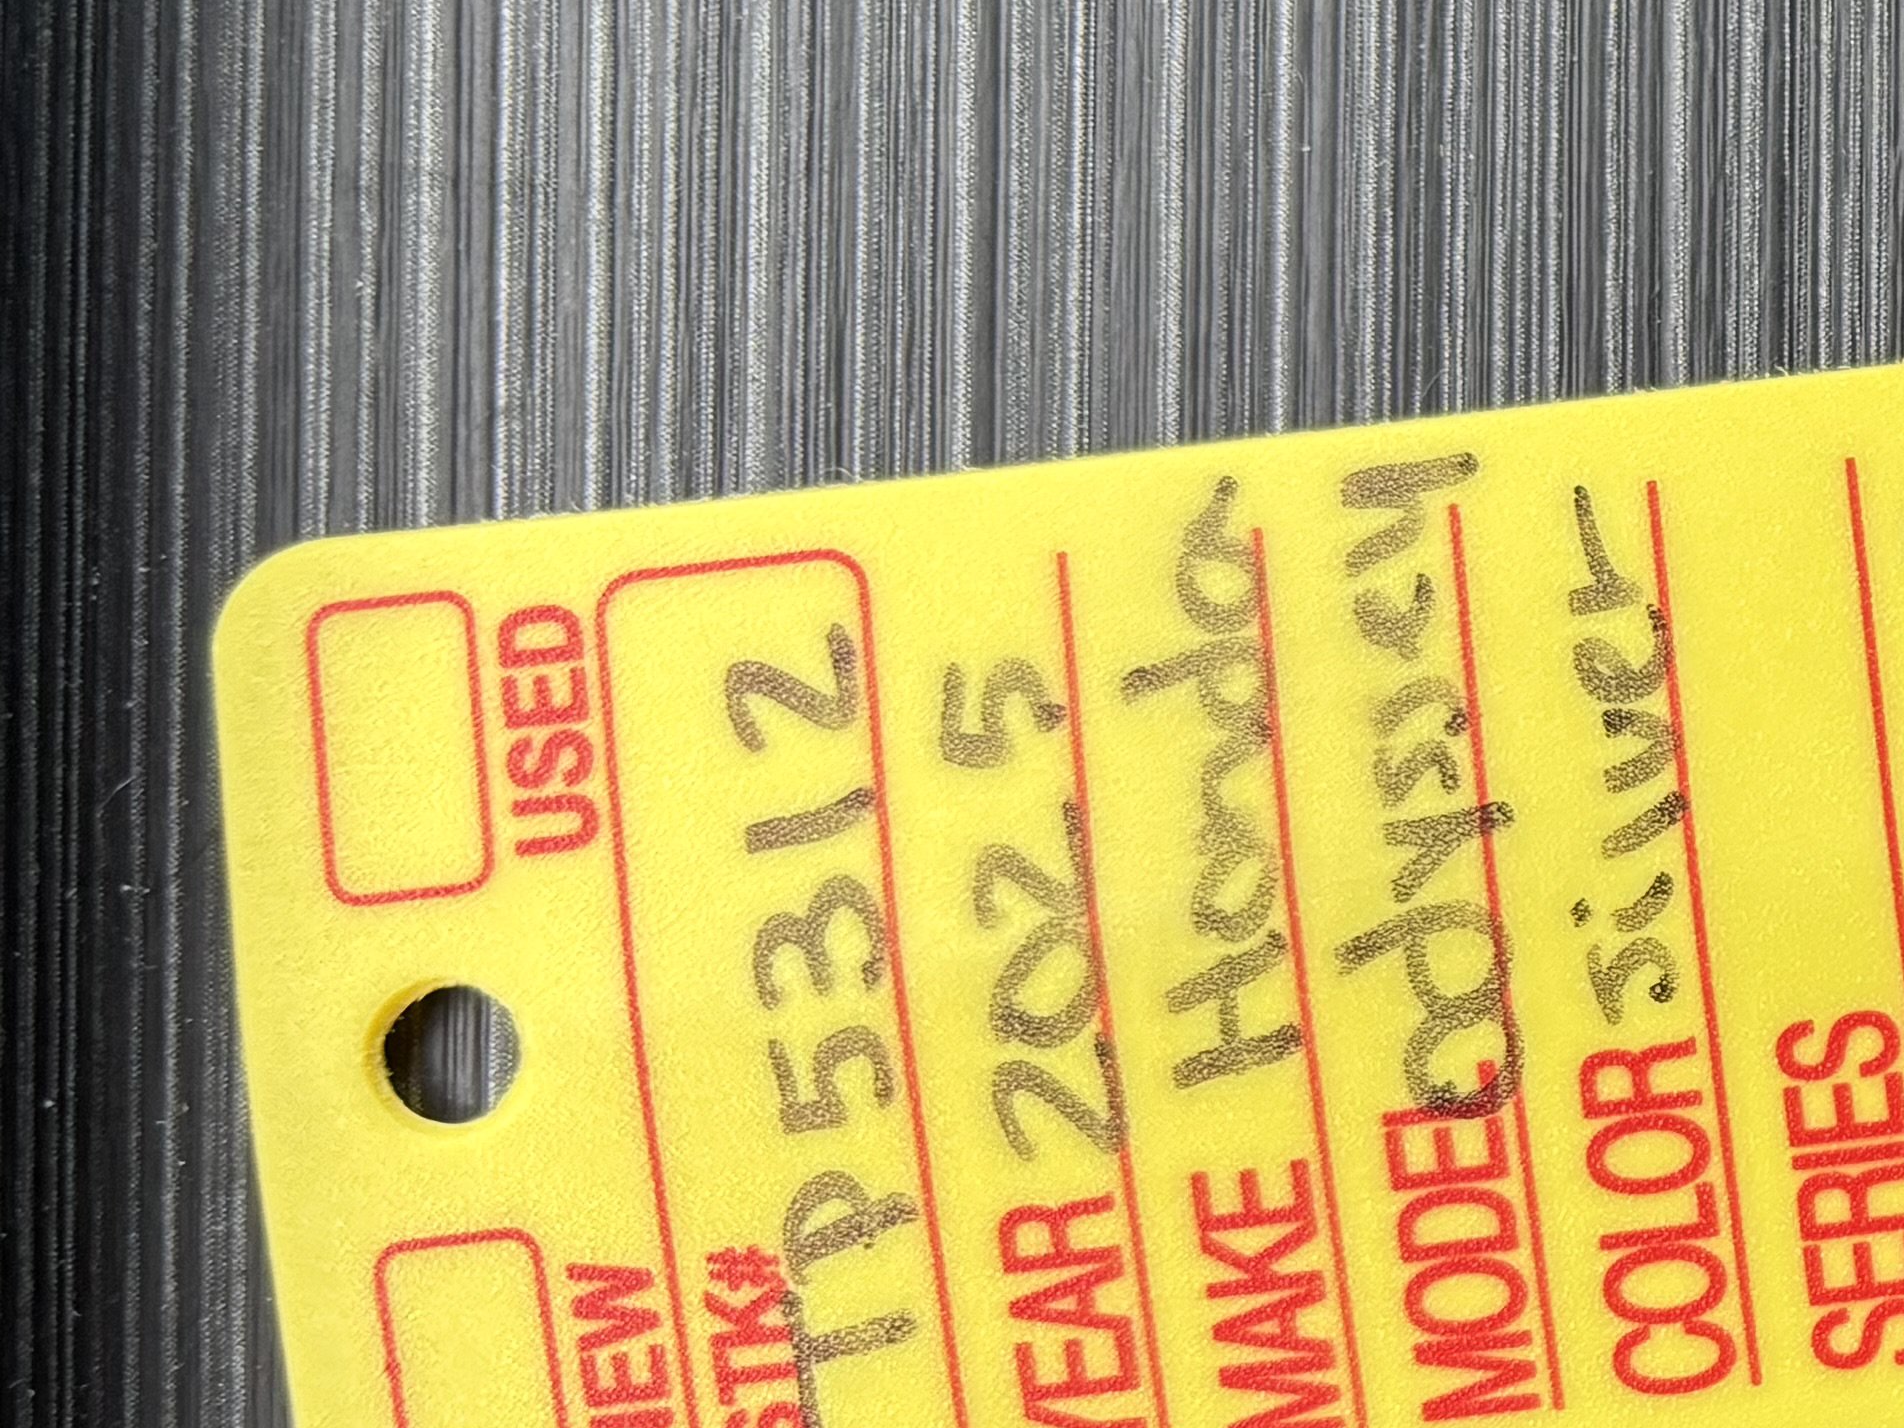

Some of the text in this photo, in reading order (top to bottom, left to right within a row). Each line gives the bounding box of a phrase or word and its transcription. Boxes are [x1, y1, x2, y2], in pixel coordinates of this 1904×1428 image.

[498, 603, 600, 858] USED
[1122, 476, 1304, 1091] Honda
[1382, 1059, 1541, 1423] MODEL
[1580, 1038, 1737, 1394] COLOR
